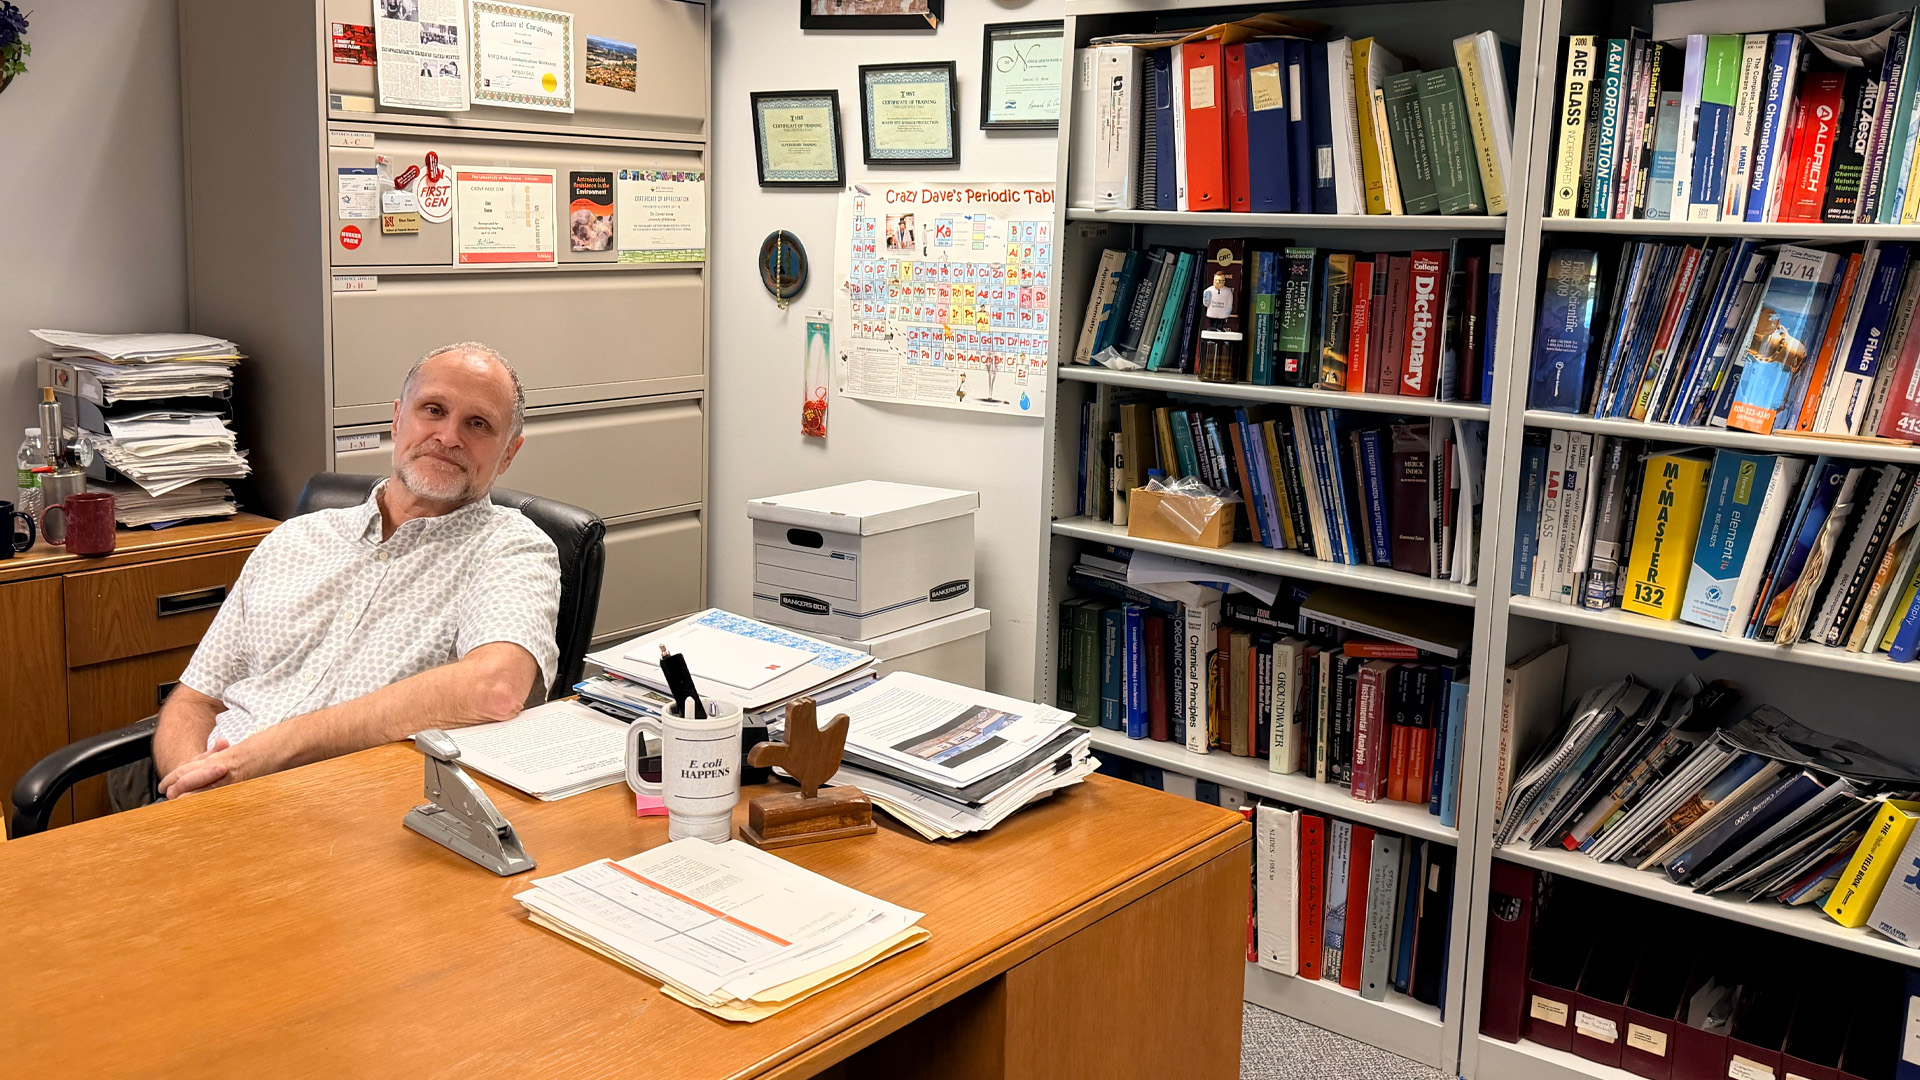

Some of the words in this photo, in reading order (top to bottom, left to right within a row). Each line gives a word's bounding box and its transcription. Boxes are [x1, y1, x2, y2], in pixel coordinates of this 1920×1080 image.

[1575, 37, 1587, 46] 2000
[1573, 49, 1588, 77] ACE
[1608, 42, 1622, 74] A&N
[1648, 44, 1663, 108] AccuStandard
[1744, 57, 1753, 91] Glassware
[1751, 70, 1760, 101] Complete
[1767, 64, 1784, 101] Alltech
[1566, 82, 1584, 126] GLASS
[1593, 87, 1601, 120] 2000-01
[1738, 92, 1747, 116] Catalog
[1862, 78, 1879, 110] Alfa
[1466, 61, 1480, 107] RADIATION
[1477, 111, 1487, 142] SAFETY
[1484, 147, 1494, 178] MANUAL
[1597, 75, 1619, 179] CORPORATION
[1745, 102, 1756, 137] Laboratory
[1413, 101, 1423, 129] METHODS
[1422, 153, 1431, 181] ANALYSIS
[1587, 122, 1598, 162] ABSOLUTE
[1751, 101, 1778, 191] Chromatography
[1854, 111, 1874, 157] Aesar
[1562, 130, 1576, 185] INCORPORATED
[1739, 146, 1748, 176] KIMBLE
[1807, 121, 1829, 192] ALDRICH
[1582, 163, 1594, 209] STANDARDS
[1800, 157, 1812, 189] Chemistry
[420, 186, 451, 197] FIRST
[424, 197, 449, 208] GEN
[886, 189, 918, 204] Crazy
[921, 189, 962, 204] Dave's
[965, 189, 1021, 204] Periodic
[1023, 189, 1055, 204] Tabl
[856, 200, 863, 211] H
[935, 224, 951, 239] Ka
[1011, 225, 1018, 235] B
[1025, 226, 1033, 236] C
[1039, 226, 1047, 235] N
[1009, 249, 1018, 257] Al
[1039, 248, 1045, 257] P
[1218, 254, 1231, 262] CRC
[854, 264, 860, 273] K
[904, 266, 910, 275] V
[914, 266, 923, 276] Cr
[926, 267, 937, 276] Mn
[953, 268, 963, 277] Co
[979, 269, 989, 277] Cu
[992, 269, 1004, 279] Zn
[1097, 266, 1110, 295] Aquatic
[1413, 263, 1439, 272] College
[1557, 260, 1572, 297] 2008/09
[1573, 261, 1586, 289] Fisher
[1779, 261, 1816, 280] 13/14
[902, 287, 912, 295] Nb
[913, 287, 925, 295] Mo
[992, 290, 1003, 299] Cd
[1008, 291, 1016, 299] In
[1298, 280, 1310, 318] Lange's
[1332, 285, 1341, 314] Physical
[965, 309, 974, 318] Pt
[1089, 295, 1102, 335] Chemistry
[1281, 280, 1295, 329] Chemistry
[1358, 299, 1367, 328] CRYSTAL
[1565, 289, 1582, 333] Scientific
[977, 316, 989, 325] Au
[1328, 313, 1341, 349] Chemistry
[1353, 304, 1362, 333] REPORTS
[1007, 337, 1018, 346] Dy
[1403, 275, 1436, 391] Dictionary
[934, 351, 940, 360] U
[1859, 337, 1879, 372] Fluka
[1018, 369, 1026, 378] Es
[1286, 445, 1294, 468] Statistical
[1290, 468, 1299, 495] Techniques
[1366, 441, 1377, 476] ELECTROSPRAY
[1611, 445, 1622, 470] MDC
[1405, 467, 1423, 475] INDEX
[1371, 476, 1379, 498] IONIZATION
[1573, 487, 1581, 512] Specialty
[1738, 476, 1748, 500] Newark
[1542, 470, 1560, 538] LABGLASS
[1898, 487, 1917, 528] phenomenex
[1375, 512, 1384, 547] SPECTROMETRY
[1647, 462, 1679, 584] McMASTER
[1878, 550, 1894, 576] HPLC
[931, 586, 954, 598] BANKERS
[954, 582, 967, 592] BOX
[1634, 583, 1665, 606] 132
[1870, 583, 1881, 596] GC
[783, 597, 812, 609] BANKERS
[813, 603, 827, 612] BOX
[1257, 609, 1270, 618] ZONE
[1825, 586, 1843, 620] Technology
[1859, 602, 1873, 622] SPE
[1174, 619, 1183, 666] ORGANIC
[1190, 635, 1199, 680] Chemical
[1173, 667, 1182, 719] CHEMISTRY
[1189, 681, 1199, 728] Principles
[1274, 672, 1286, 748] GROUNDWATER
[1360, 684, 1368, 731] Instrumental
[1502, 703, 1510, 734] VACUUM
[1356, 733, 1366, 765] Analysis
[681, 768, 730, 779] HAPPENS
[689, 760, 700, 769] E.
[702, 758, 723, 769] coli
[1495, 737, 1507, 811] INSTRUMENTATION
[1752, 792, 1775, 813] Catalog
[1523, 818, 1539, 836] Thermo
[1734, 811, 1751, 826] 2000
[1881, 822, 1892, 836] THE
[1862, 853, 1874, 872] FIELD
[1851, 869, 1865, 889] BOOK
